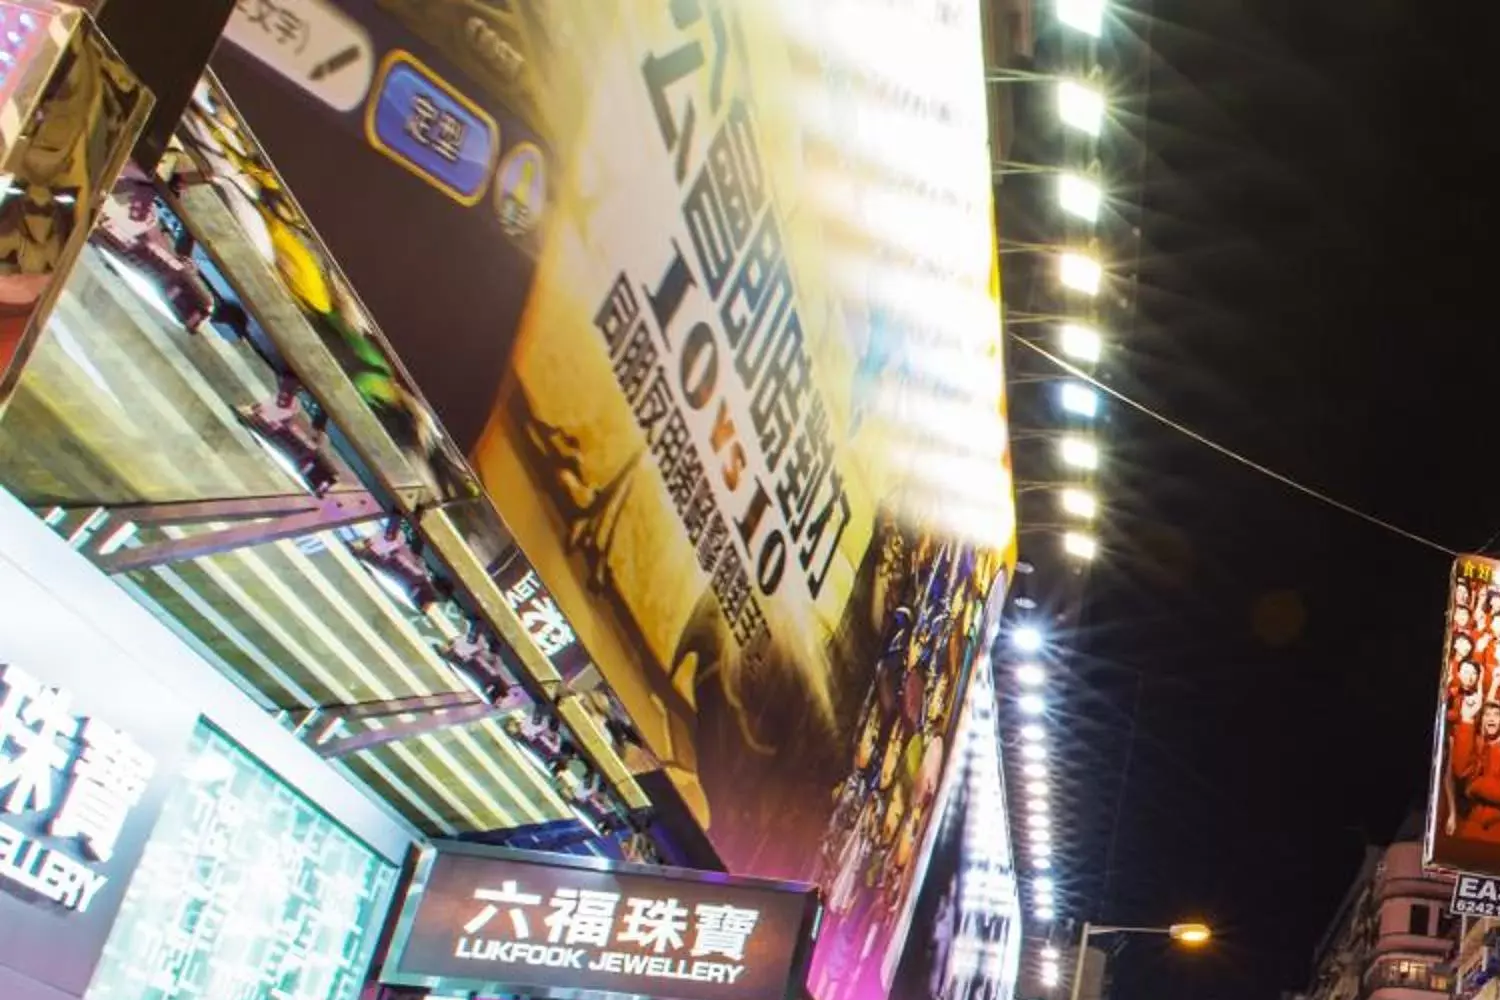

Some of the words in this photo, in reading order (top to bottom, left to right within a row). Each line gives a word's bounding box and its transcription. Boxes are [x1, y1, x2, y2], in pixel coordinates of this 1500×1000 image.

[642, 237, 719, 410] 10
[734, 476, 786, 596] 10
[462, 880, 760, 958] 六福珠寶
[454, 937, 583, 970] LUKFOOK
[590, 953, 745, 985] JEWELLERY
